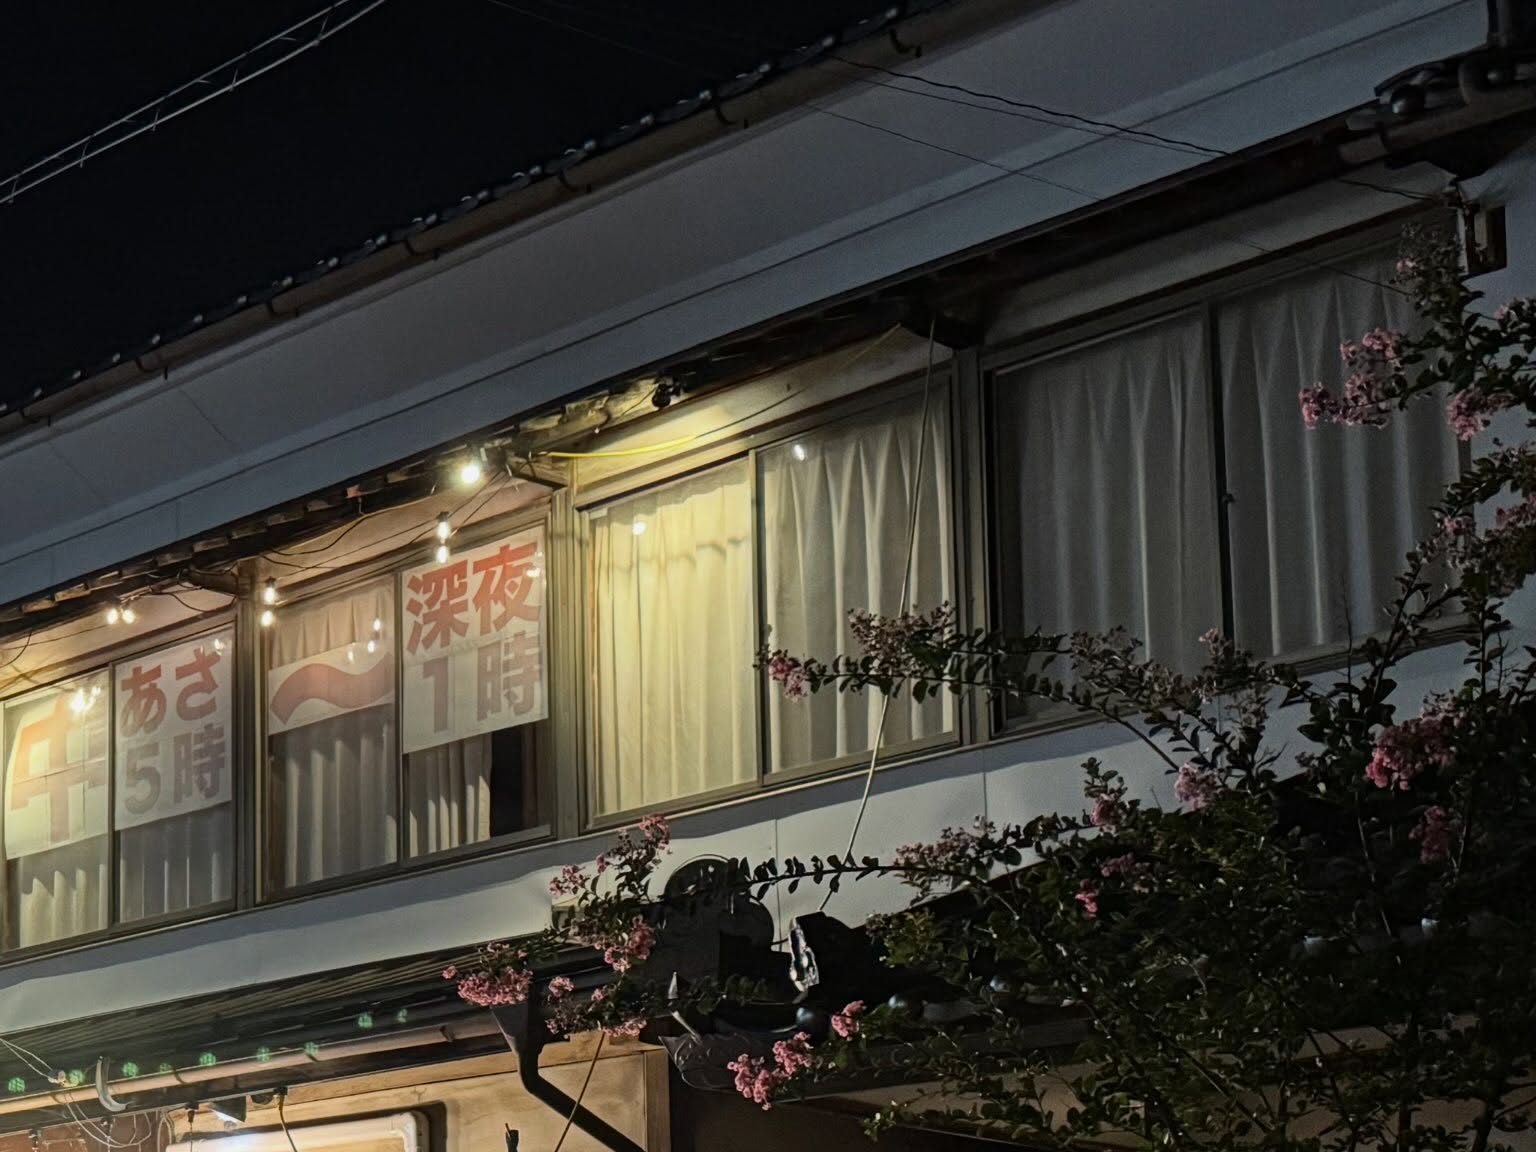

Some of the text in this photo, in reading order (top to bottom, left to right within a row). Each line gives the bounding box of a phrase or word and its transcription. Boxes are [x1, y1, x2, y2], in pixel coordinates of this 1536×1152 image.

[406, 542, 542, 655] 深夜
[120, 646, 222, 738] あさ
[422, 631, 542, 735] 1時
[125, 722, 225, 816] 5時
